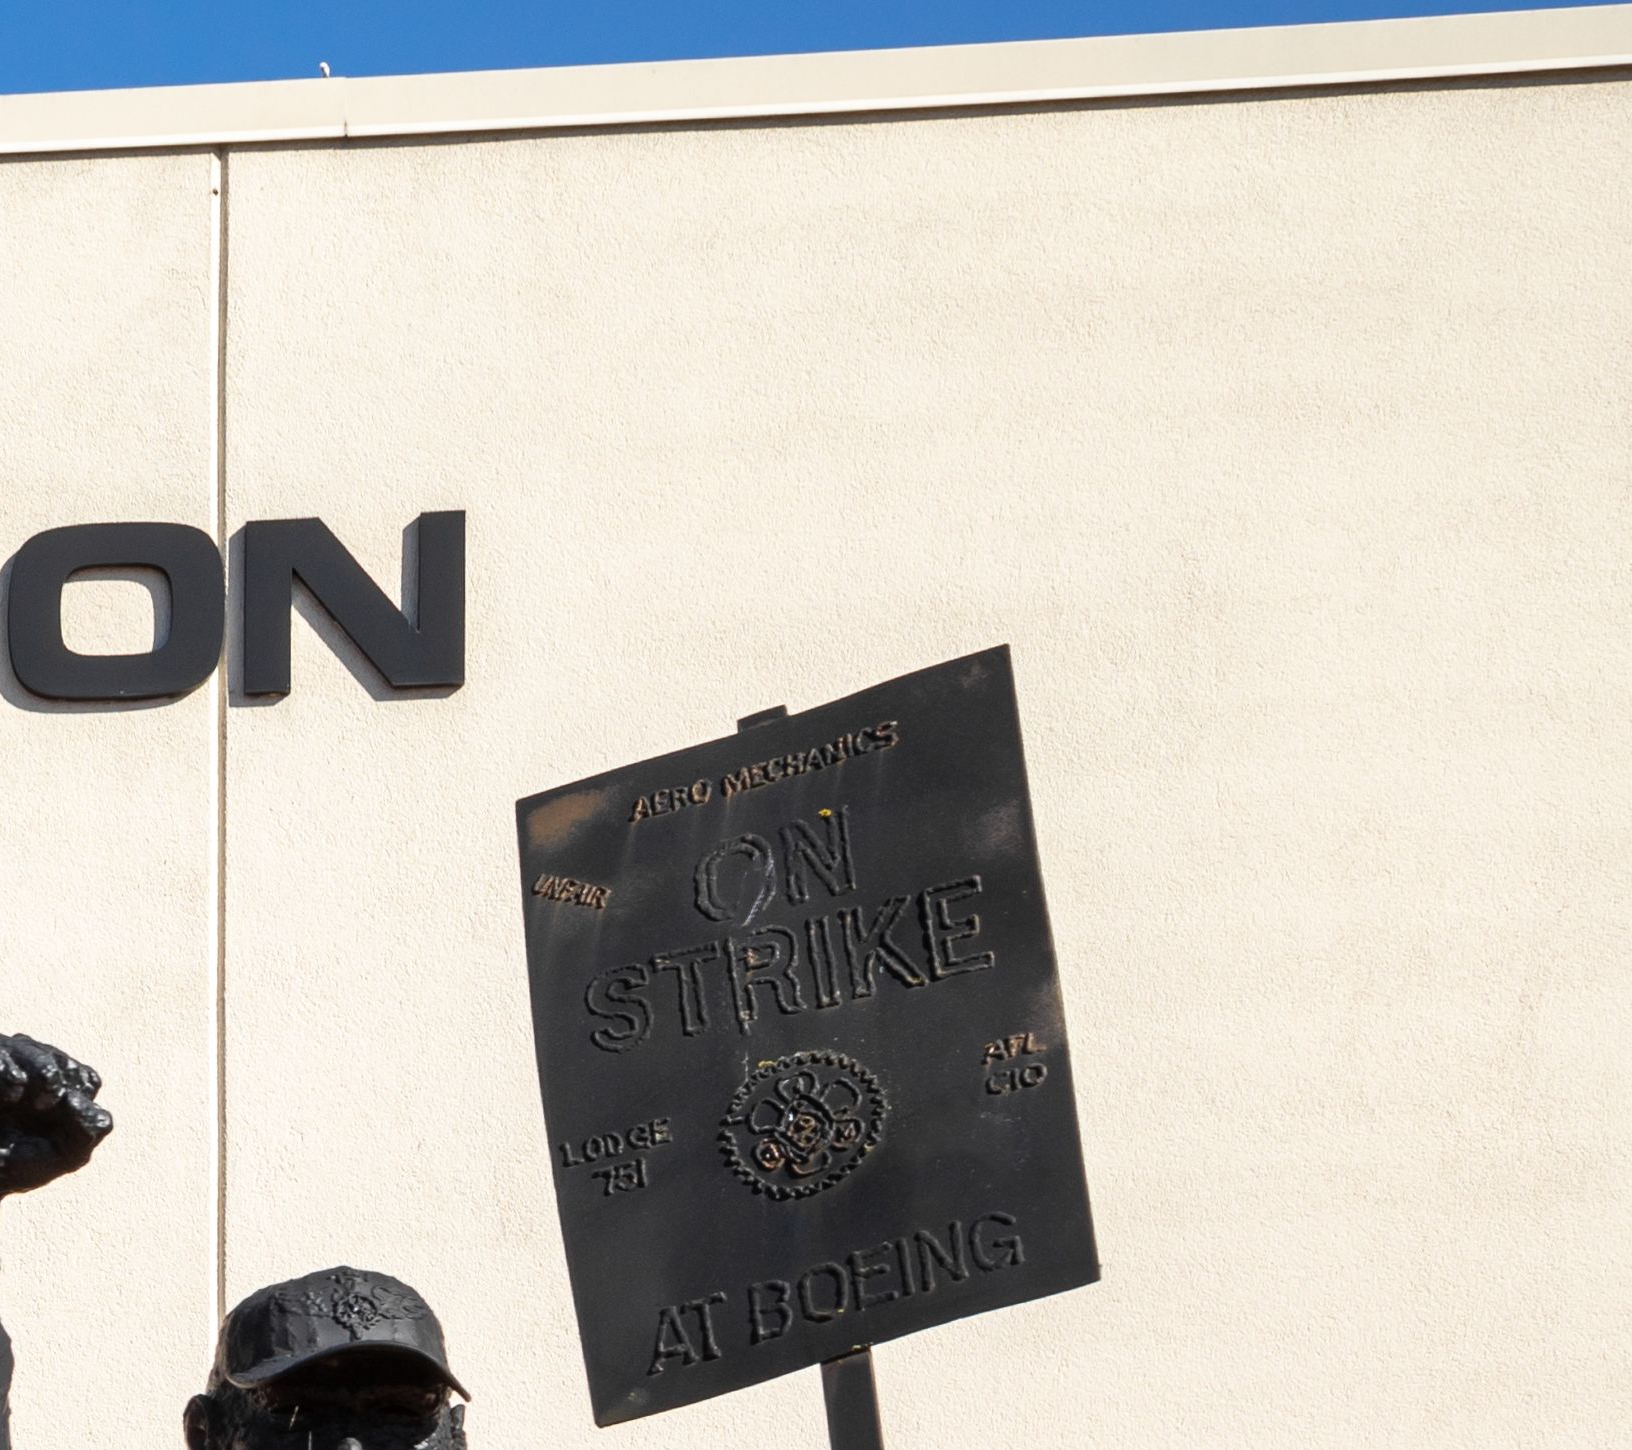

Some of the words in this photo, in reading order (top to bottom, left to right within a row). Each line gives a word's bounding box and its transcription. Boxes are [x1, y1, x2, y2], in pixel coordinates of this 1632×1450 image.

[628, 778, 712, 823] AERO
[720, 720, 899, 797] MECHANICS
[694, 804, 857, 925] ON
[532, 873, 613, 911] UNFAIR
[585, 874, 996, 1053] STRIKE
[980, 1032, 1049, 1067] AFL
[985, 1062, 1049, 1096] CIO
[559, 1117, 673, 1168] LODGE
[591, 1156, 649, 1197] 751
[647, 1290, 728, 1376] AT
[749, 1210, 1026, 1346] BOEING
